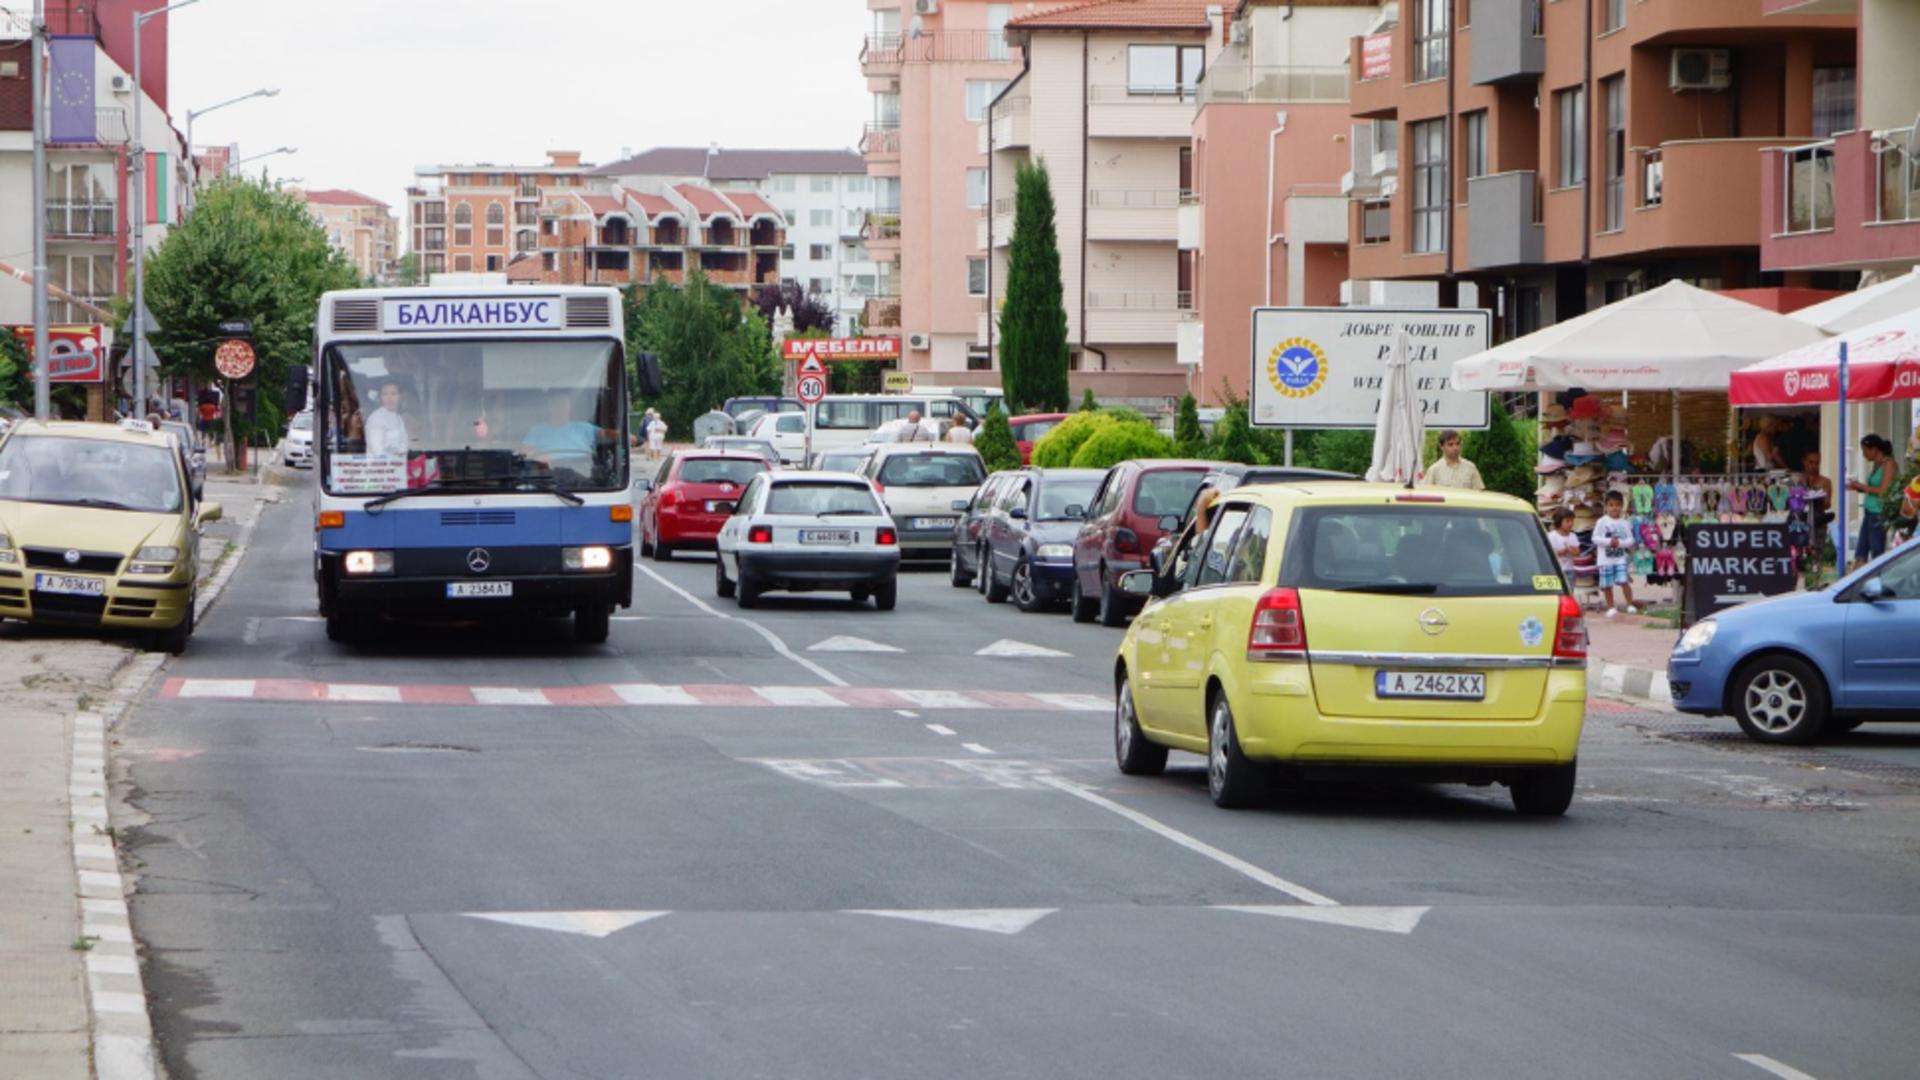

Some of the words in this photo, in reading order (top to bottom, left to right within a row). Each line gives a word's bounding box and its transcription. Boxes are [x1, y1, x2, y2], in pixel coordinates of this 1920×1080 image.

[398, 302, 549, 325] БАЛКАНБУС
[1340, 323, 1393, 337] ДОБРЕ
[1465, 324, 1475, 337] В
[791, 340, 893, 353] МЕБЕЛИ
[1377, 346, 1438, 361] РДА
[1438, 377, 1452, 390] T
[1801, 372, 1829, 389] ALGIDA
[803, 382, 820, 396] 30
[1696, 530, 1783, 549] SUPER
[1692, 557, 1792, 575] MARKET
[1726, 579, 1736, 593] 5
